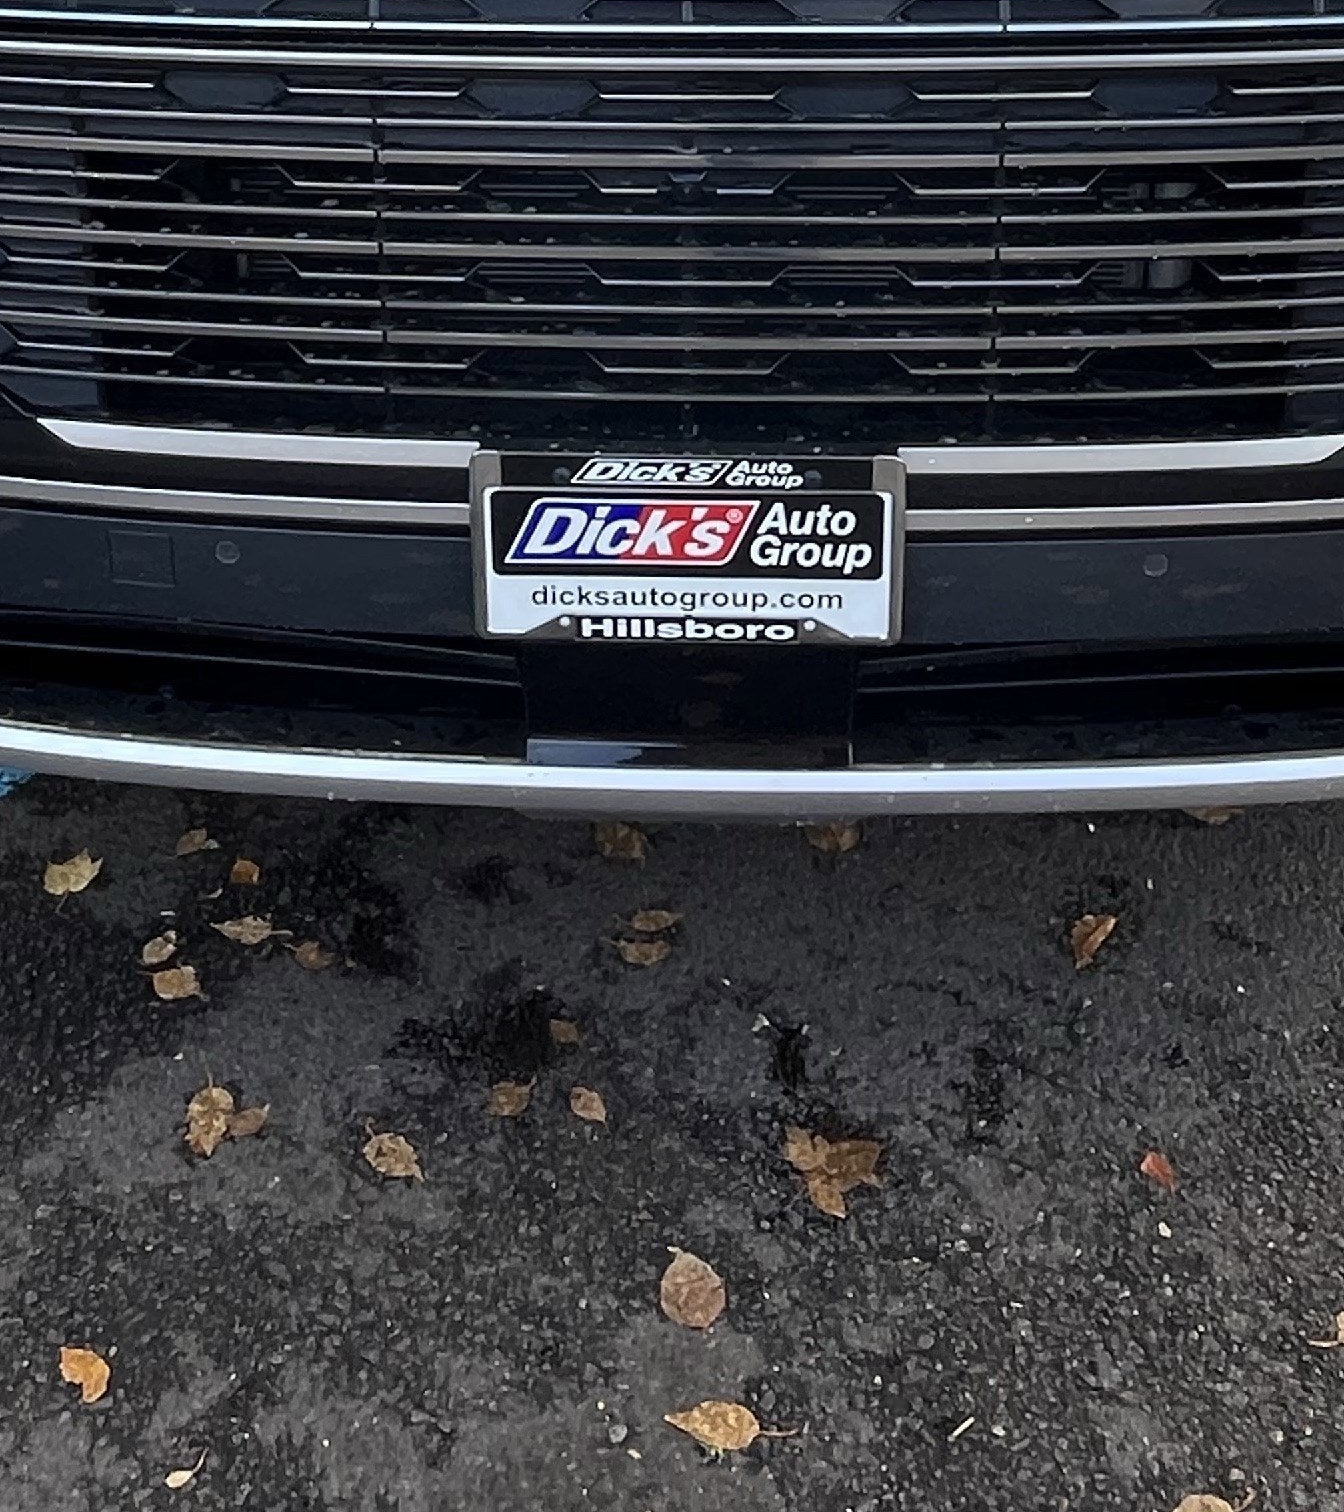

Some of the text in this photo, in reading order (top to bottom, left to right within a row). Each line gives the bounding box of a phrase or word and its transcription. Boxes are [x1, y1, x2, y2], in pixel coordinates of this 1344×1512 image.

[736, 460, 794, 475] Auto
[725, 472, 804, 489] Group
[757, 501, 857, 537] Auto
[750, 537, 873, 574] Group
[531, 585, 843, 611] dicksautogroup.com
[580, 617, 795, 641] Hillsboro
